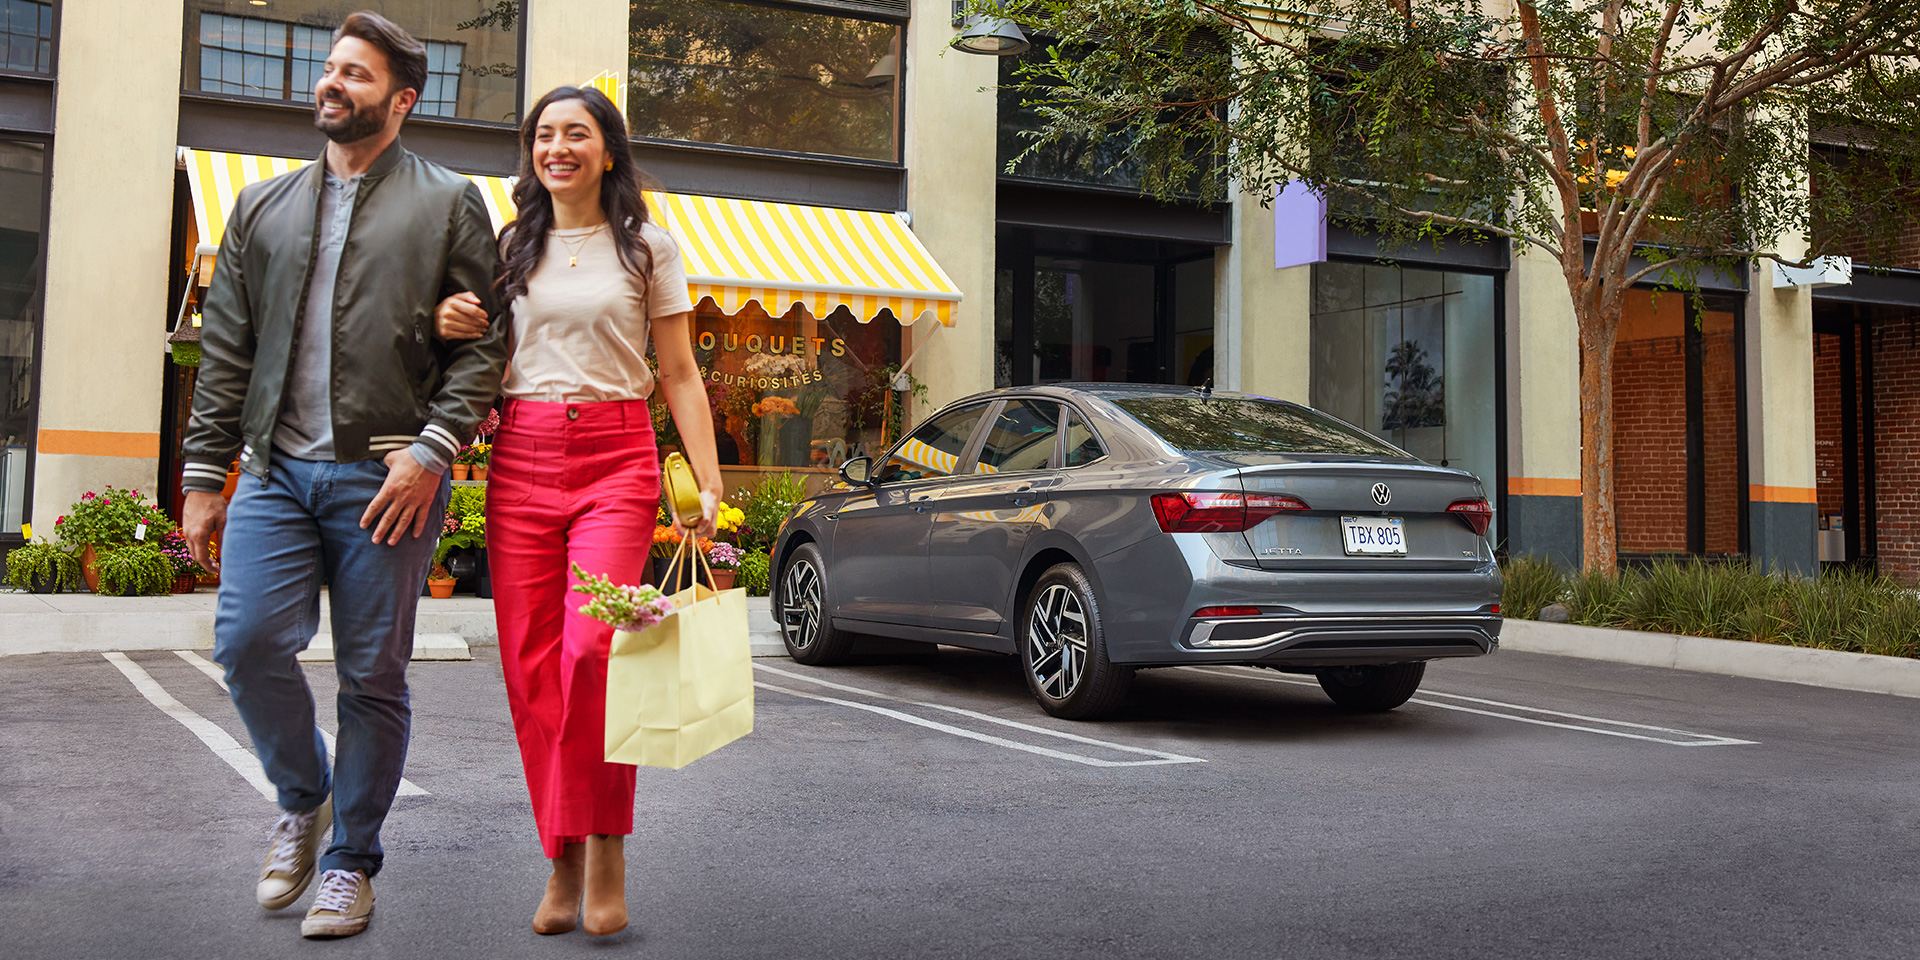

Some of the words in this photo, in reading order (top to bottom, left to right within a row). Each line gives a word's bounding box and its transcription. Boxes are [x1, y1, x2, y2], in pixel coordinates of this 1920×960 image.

[698, 331, 846, 357] OUQUETS
[1348, 525, 1375, 545] TBX
[1376, 526, 1401, 546] 805
[1260, 547, 1303, 556] JETTA
